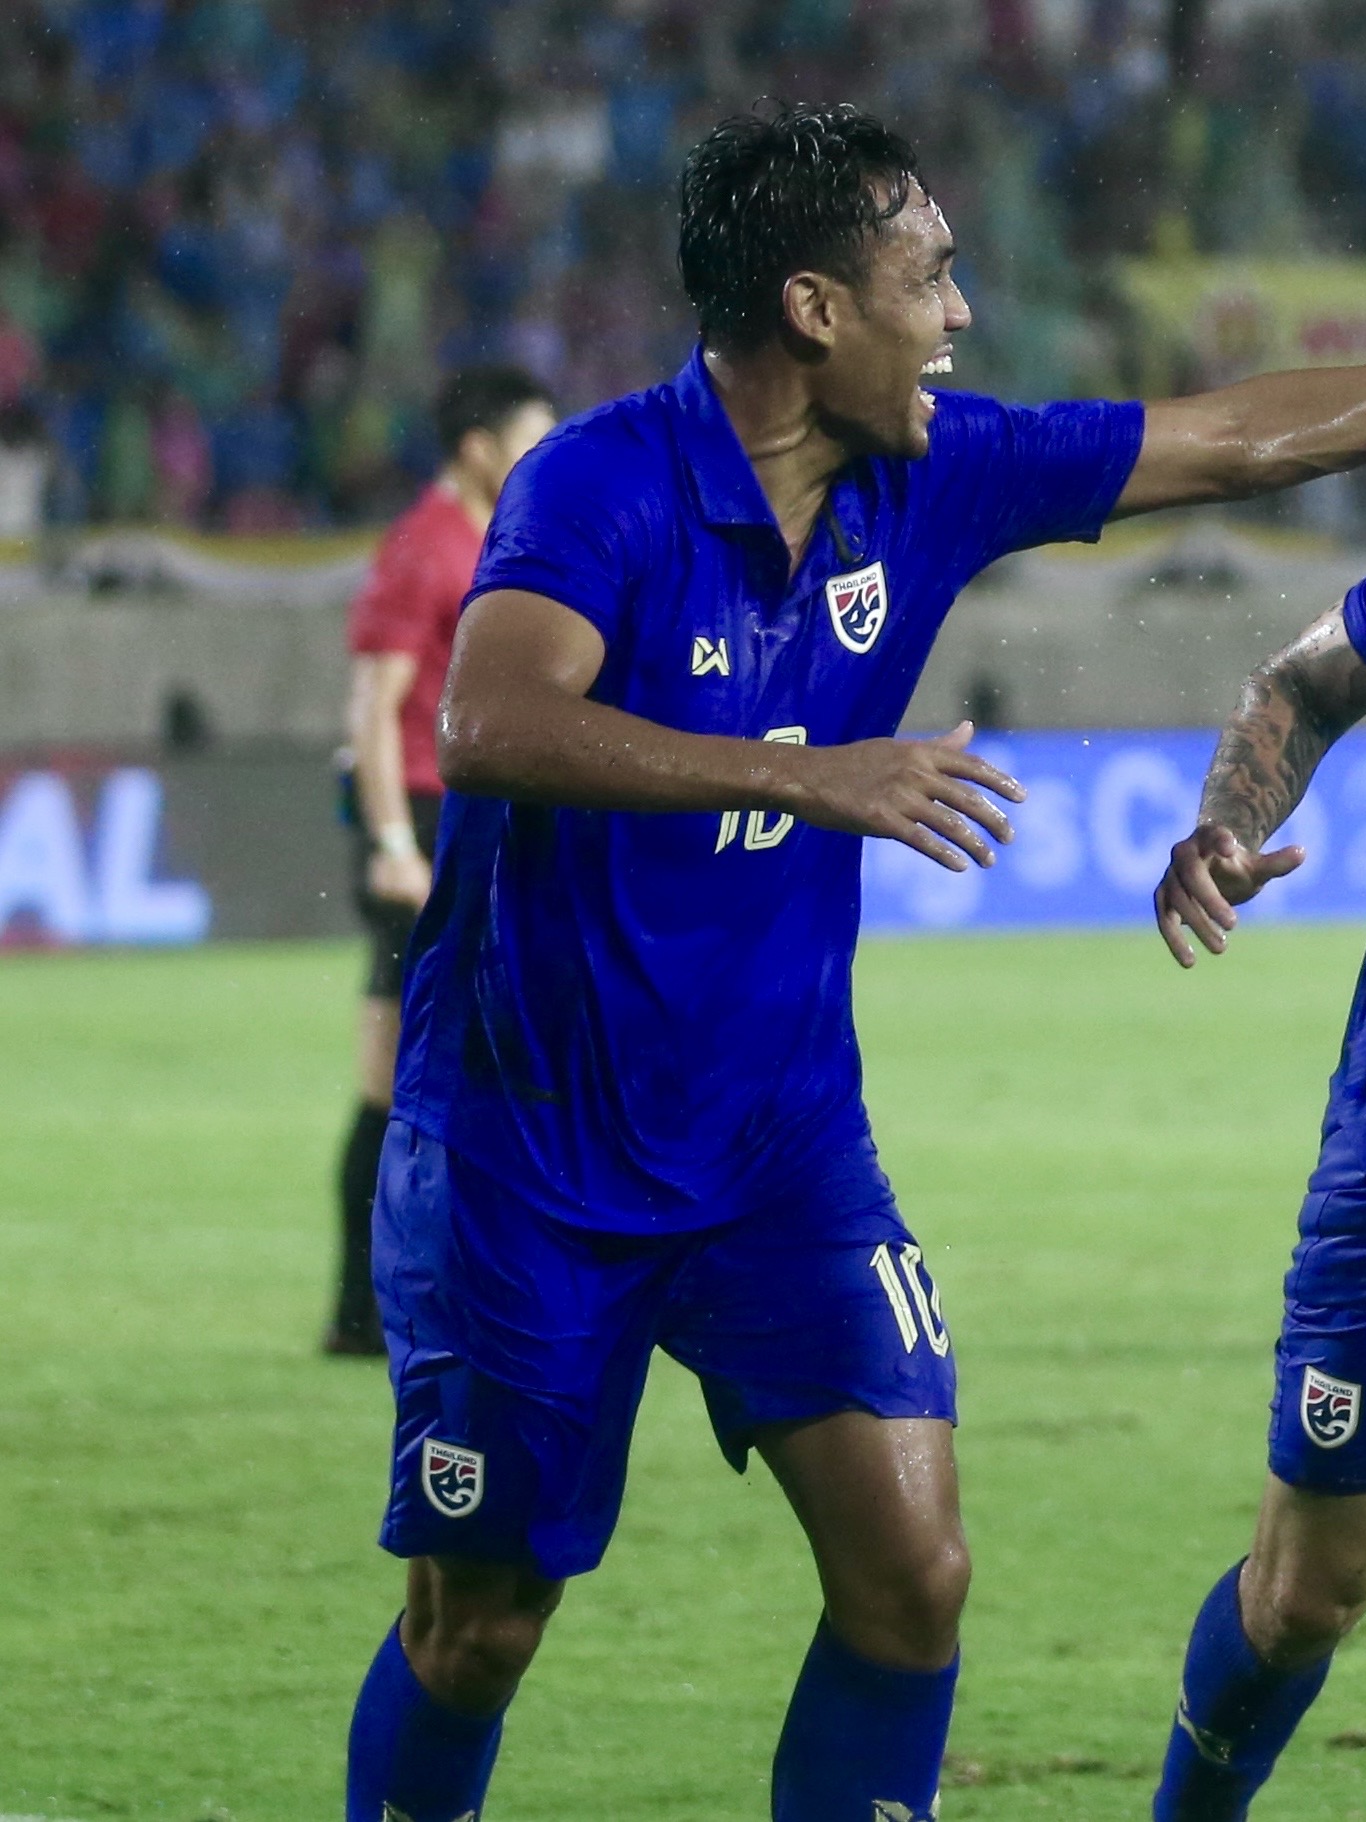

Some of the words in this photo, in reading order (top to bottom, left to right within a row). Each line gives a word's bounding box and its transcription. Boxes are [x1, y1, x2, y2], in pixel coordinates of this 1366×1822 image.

[831, 572, 878, 592] THAILAND
[1310, 1375, 1353, 1397] THAILAND
[430, 1446, 477, 1465] THAILAND
